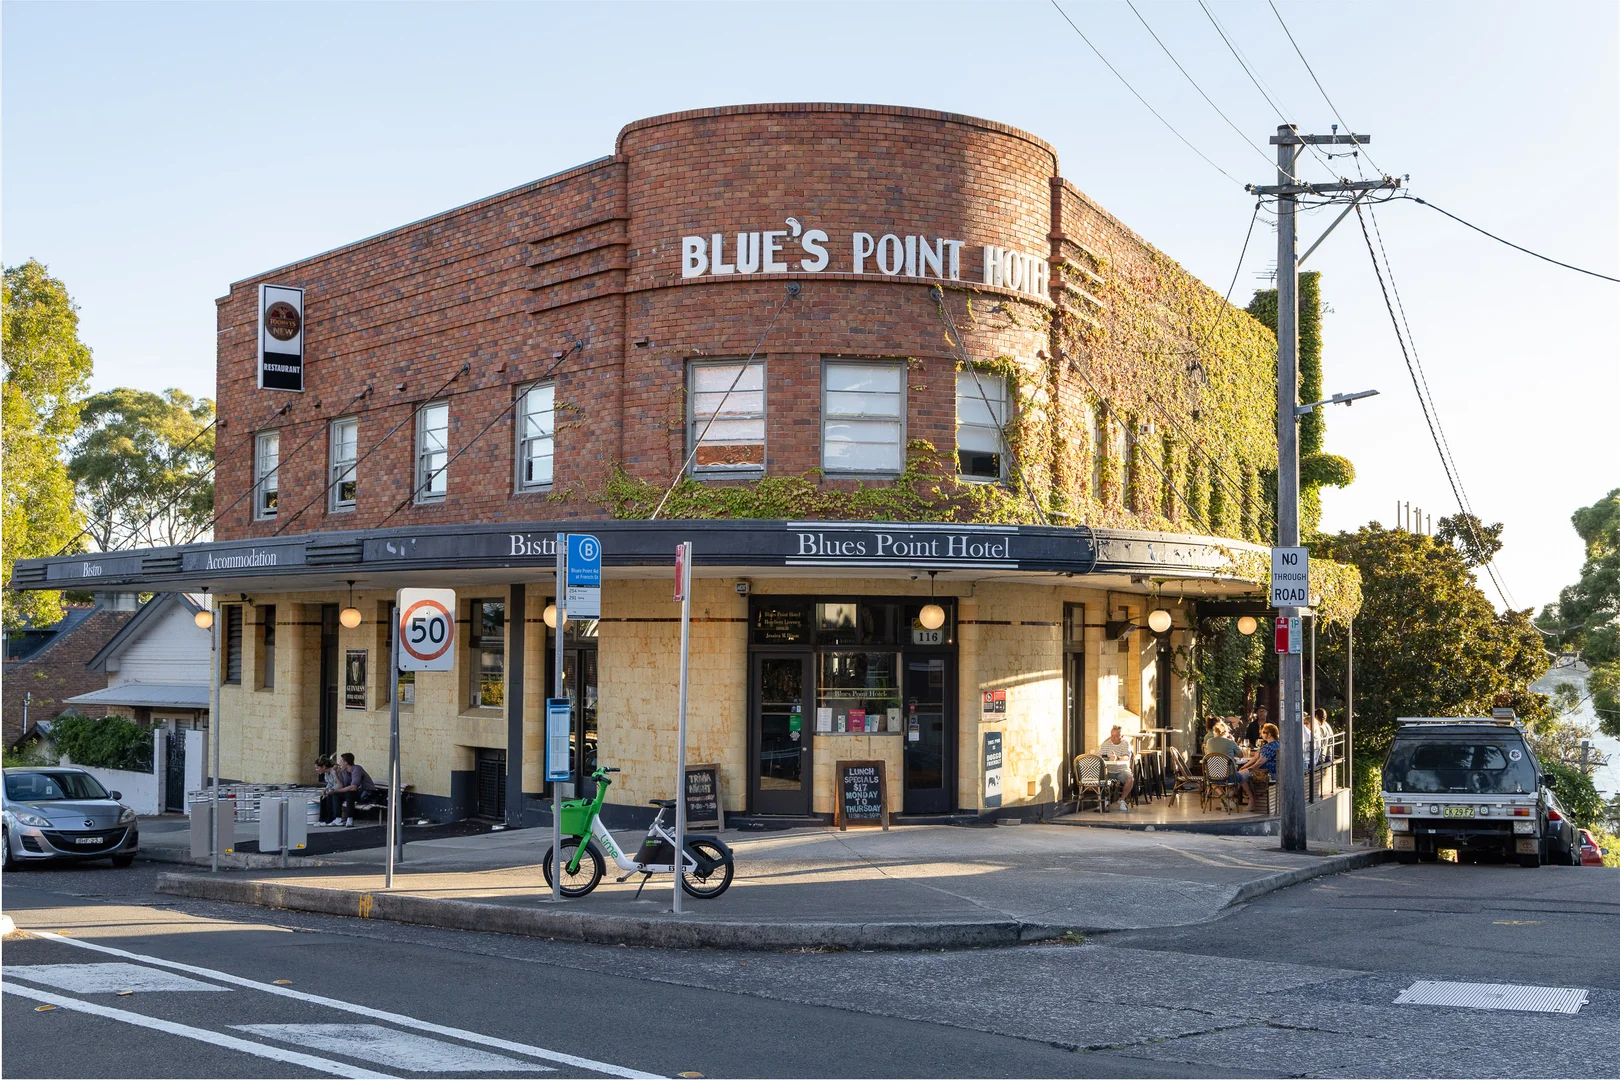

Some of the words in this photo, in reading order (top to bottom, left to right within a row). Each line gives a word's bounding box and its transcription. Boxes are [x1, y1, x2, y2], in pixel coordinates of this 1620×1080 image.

[852, 232, 965, 281] POINT
[983, 246, 1051, 301] HOTEL
[272, 328, 294, 336] NEW
[264, 363, 300, 374] RESTAURANT
[509, 534, 567, 556] Bistr
[796, 533, 866, 556] Blues
[874, 534, 940, 556] Point
[946, 535, 1010, 558] Hotel
[206, 548, 277, 570] Accommodation
[1282, 553, 1298, 566] NO
[82, 562, 102, 578] Bistro
[1274, 588, 1305, 600] ROAD
[1291, 620, 1299, 628] 1P
[411, 617, 445, 644] 50
[919, 632, 938, 642] 116
[849, 768, 874, 776] LUNCH
[853, 783, 868, 792] $17
[846, 791, 878, 799] MONDAY
[846, 805, 882, 813] THURSDAY
